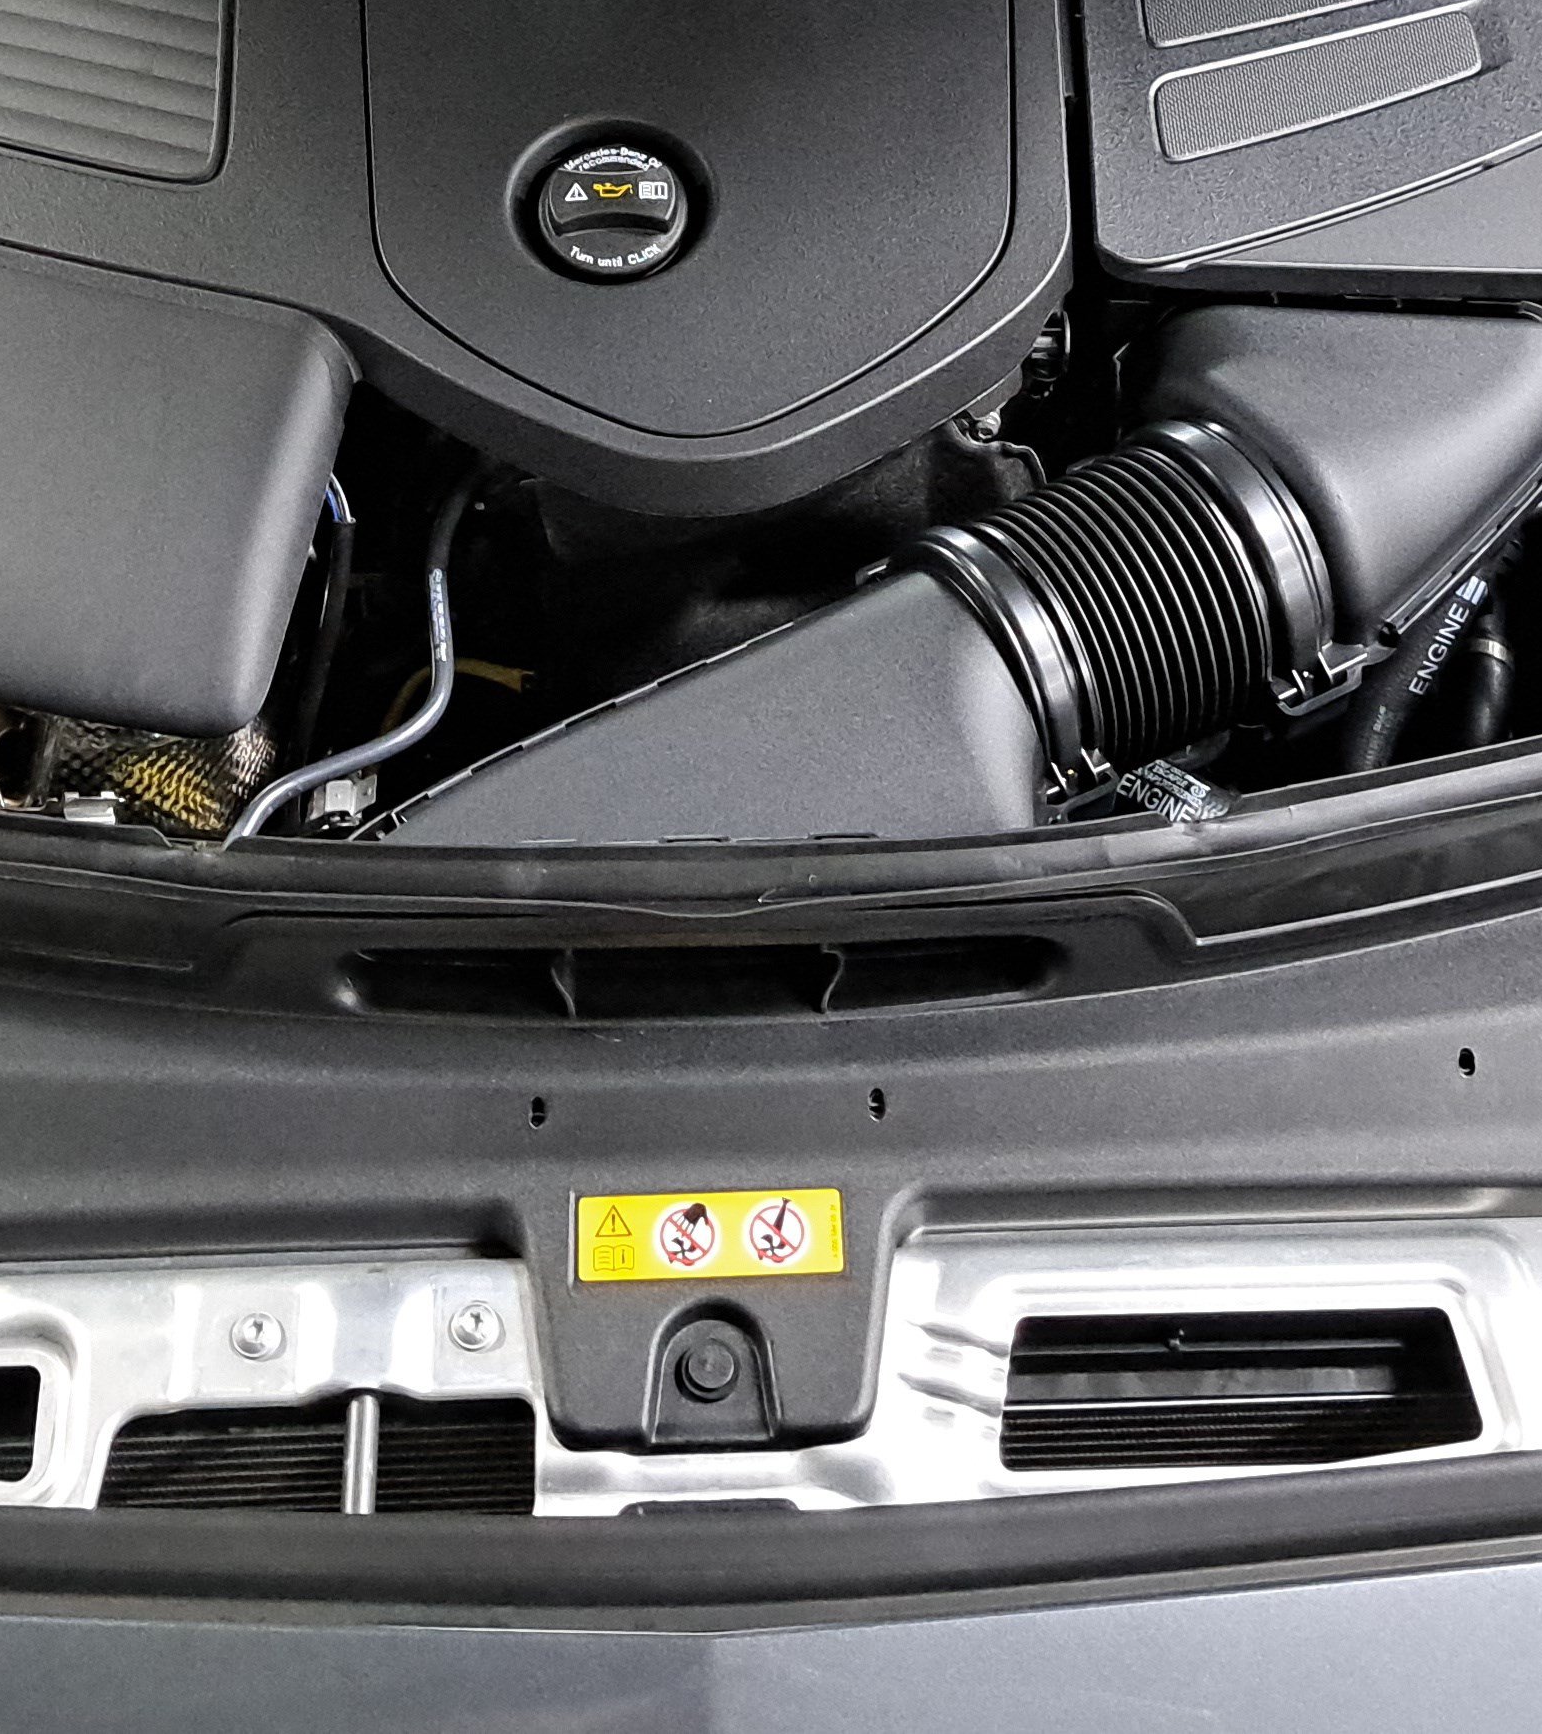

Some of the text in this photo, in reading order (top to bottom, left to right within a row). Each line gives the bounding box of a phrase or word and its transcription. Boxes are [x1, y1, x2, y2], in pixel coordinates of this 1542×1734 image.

[570, 243, 662, 267] Turn until CLICK
[1408, 602, 1471, 696] ENGINE
[1116, 773, 1196, 823] ENGINE
